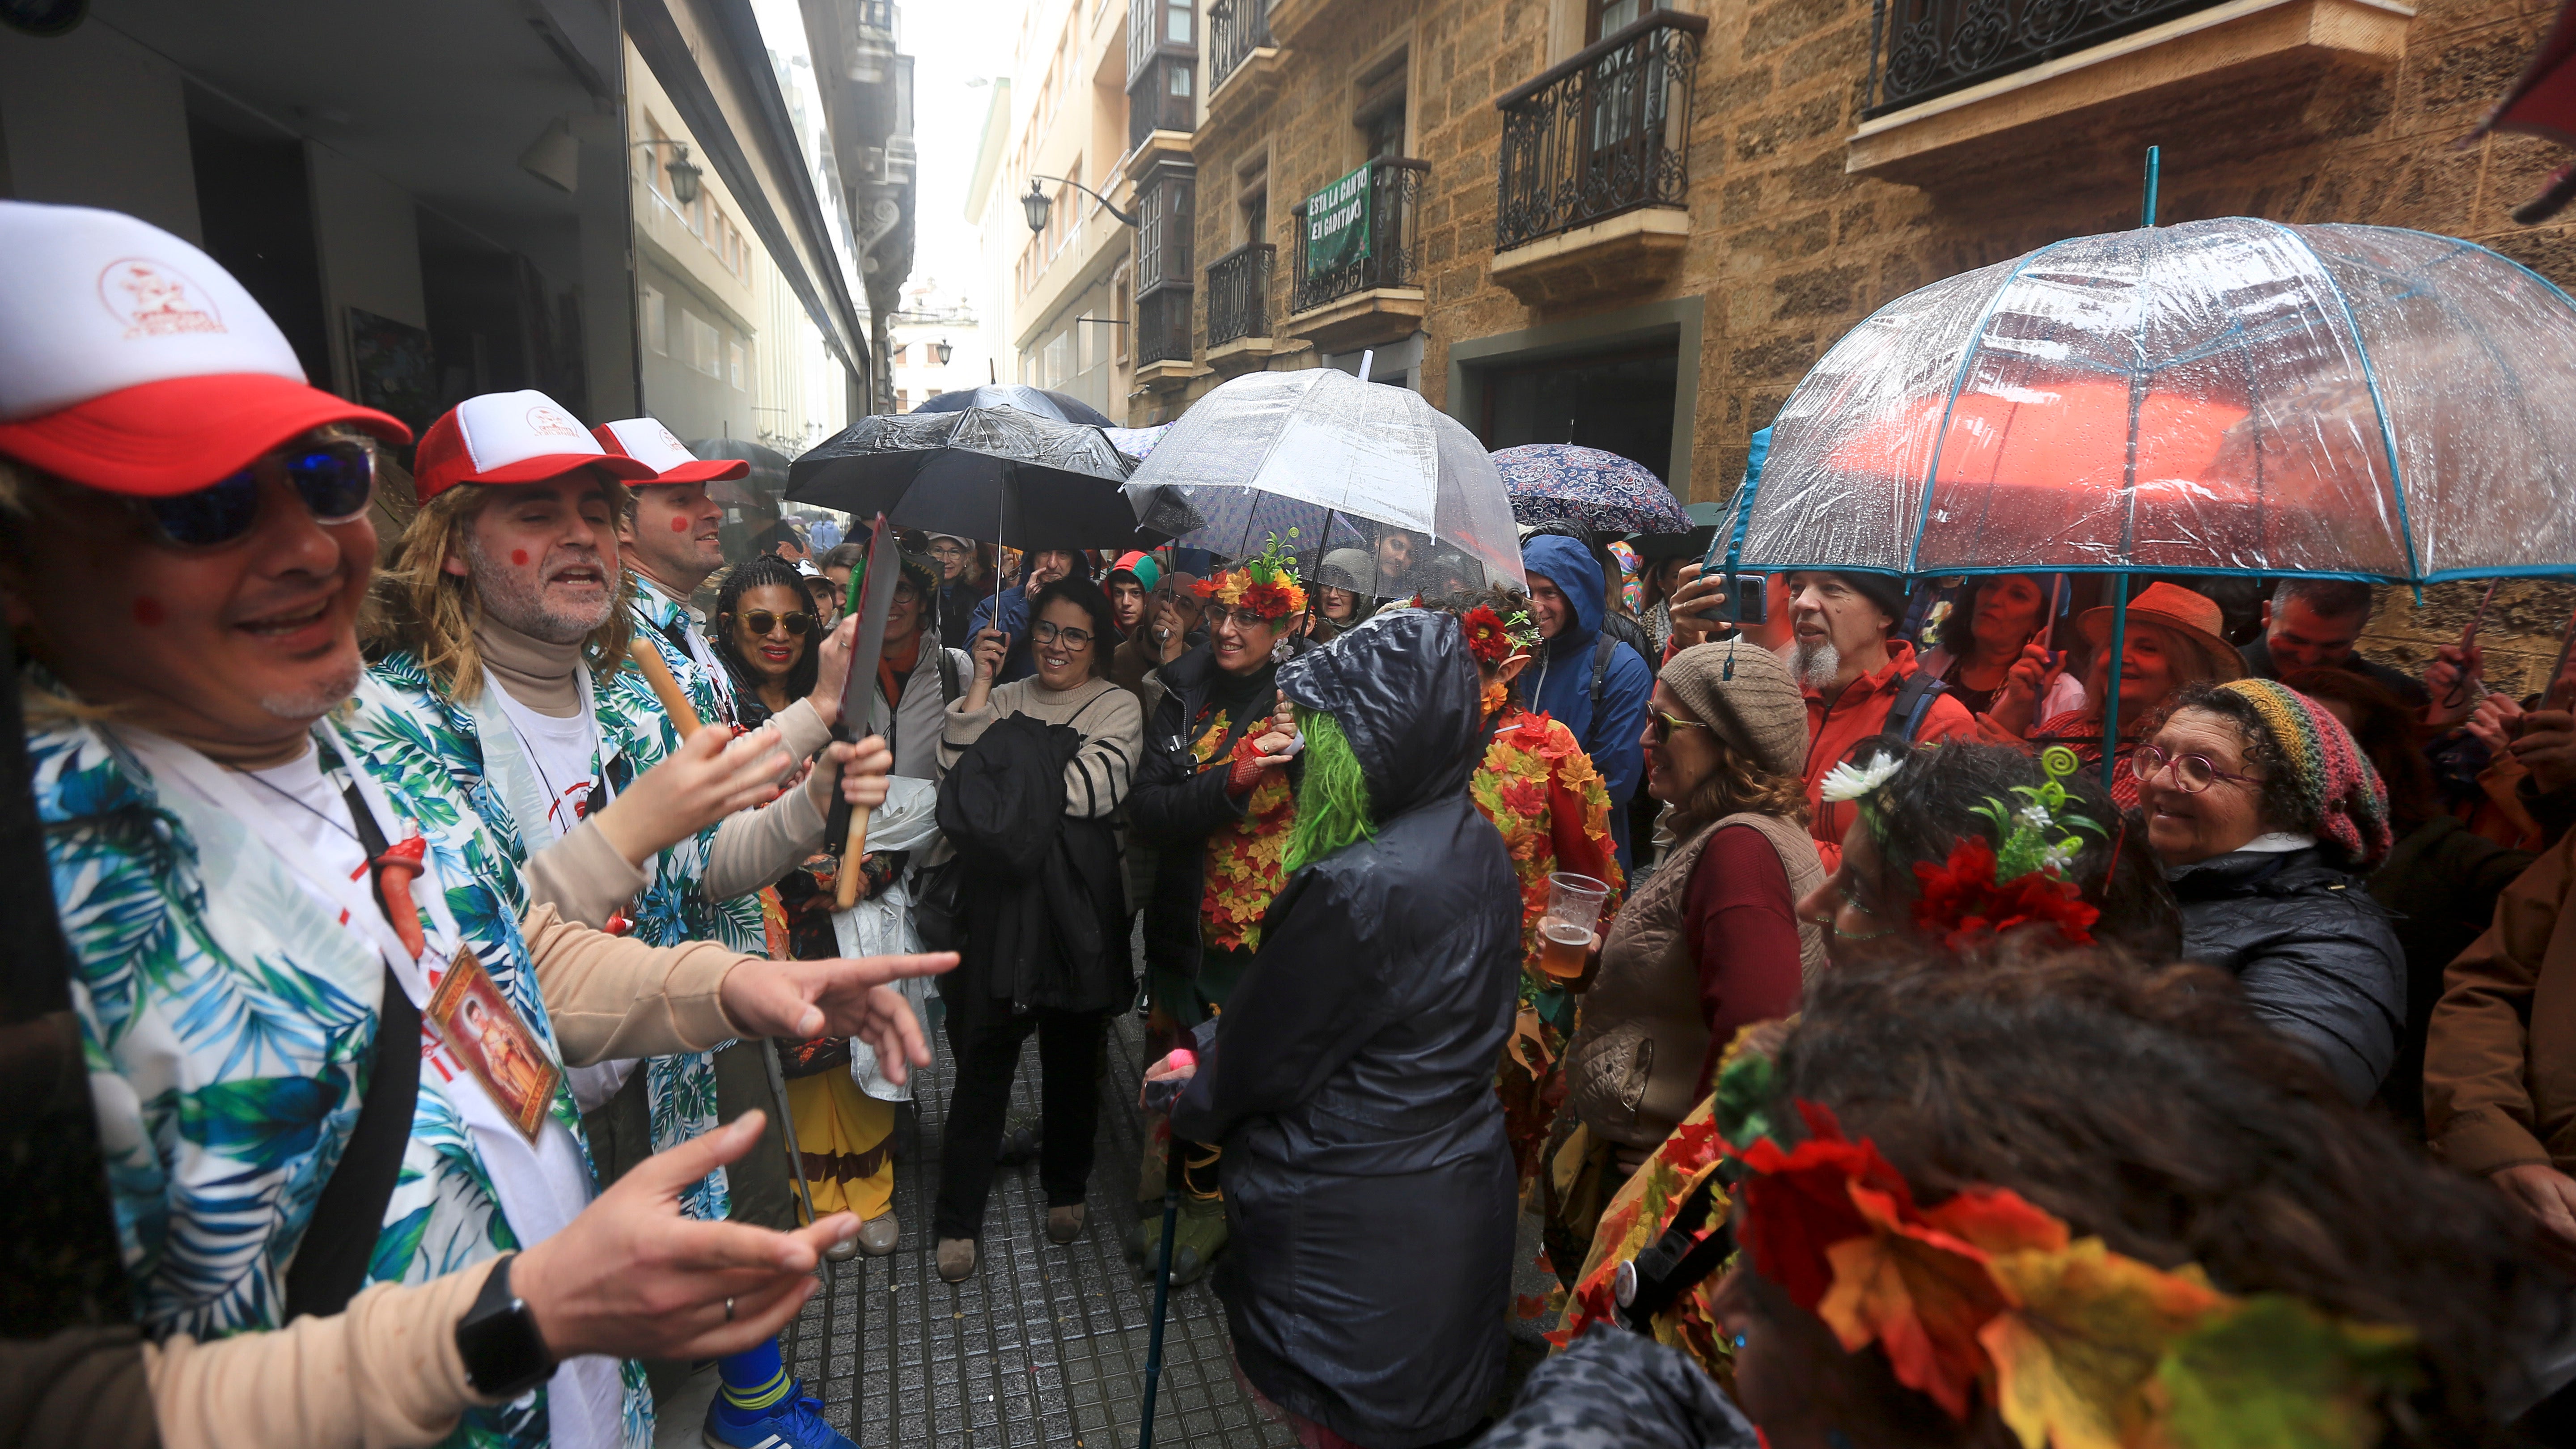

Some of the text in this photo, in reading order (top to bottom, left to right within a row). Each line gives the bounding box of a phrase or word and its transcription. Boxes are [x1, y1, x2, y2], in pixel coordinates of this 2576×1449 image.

[1309, 167, 1368, 216] ESTA LA CANTO
[1311, 220, 1322, 240] EN
